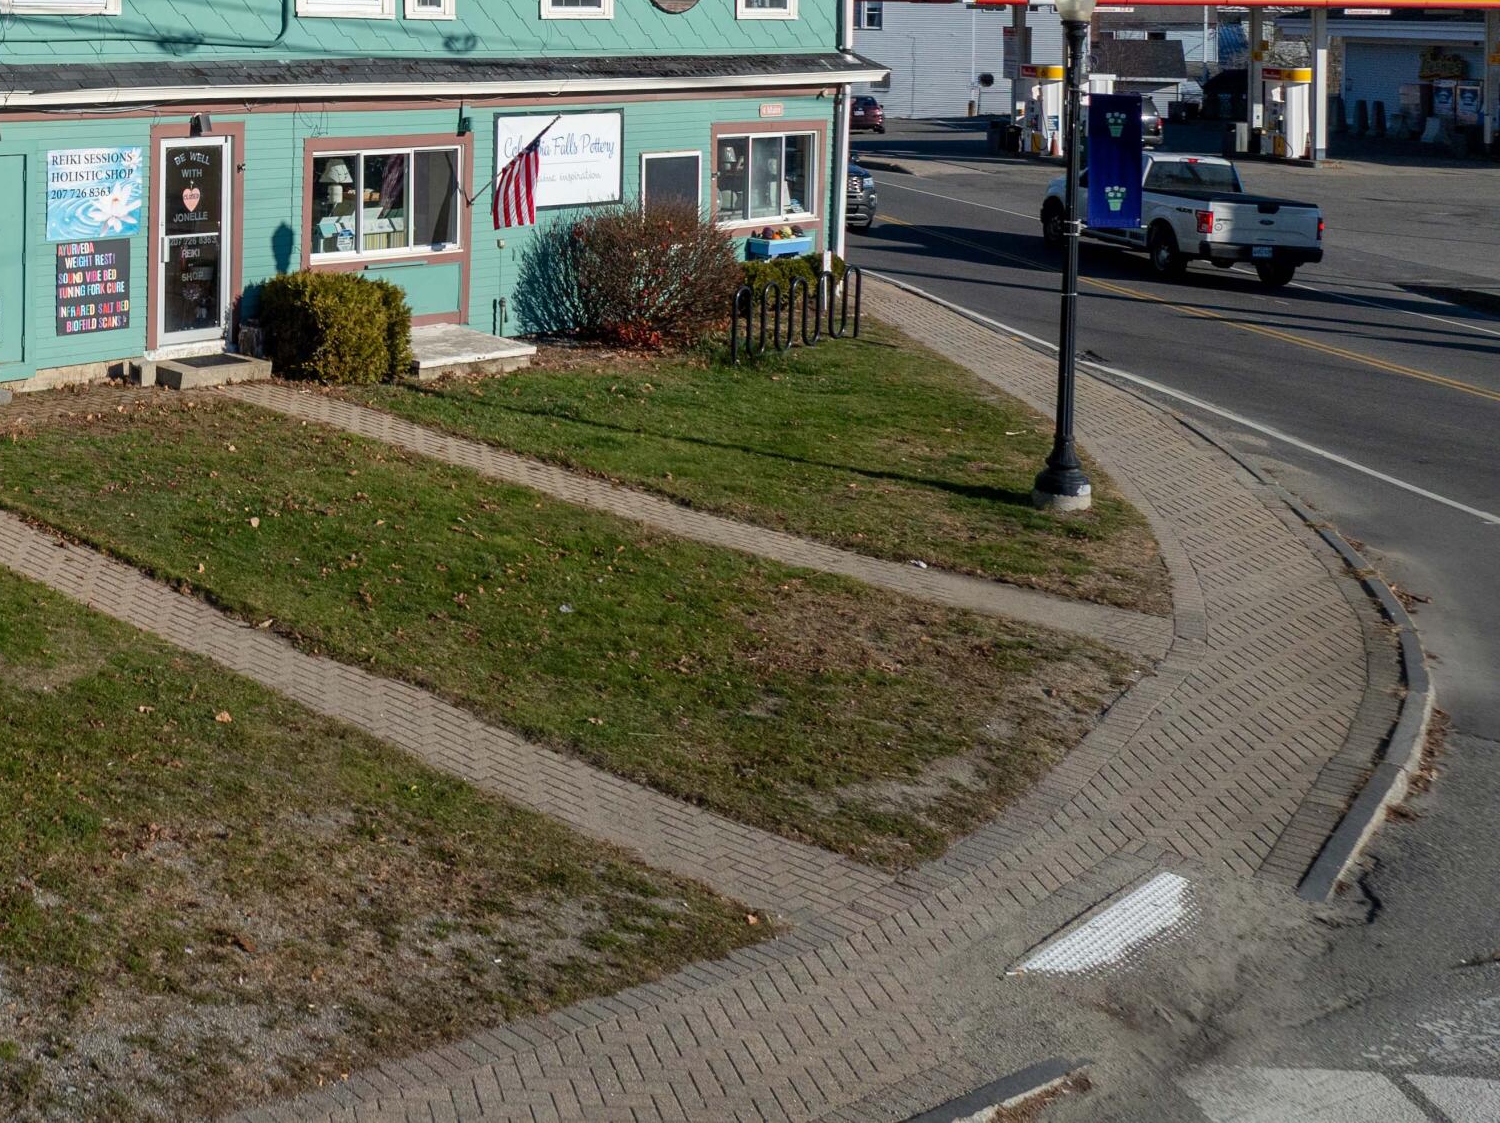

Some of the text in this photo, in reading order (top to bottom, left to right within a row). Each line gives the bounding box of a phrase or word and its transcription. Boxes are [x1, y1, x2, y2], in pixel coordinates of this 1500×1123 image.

[551, 133, 578, 156] Falls
[580, 133, 615, 159] Pottery
[51, 152, 133, 166] REIKI SESSIONS
[174, 151, 210, 166] BE WELL
[51, 168, 134, 183] HOLISTIC SHOP
[181, 168, 203, 178] WITH
[51, 187, 111, 200] 207 726 8363
[173, 211, 209, 222] JONELLE
[58, 242, 95, 256] AYURVEDA
[181, 248, 201, 258] REIKI
[65, 255, 93, 269] WEIGHT
[58, 269, 117, 285] SOUND VIBE BED
[87, 283, 105, 296] FORK
[106, 281, 125, 294] CURE
[59, 300, 129, 318] INFRARED SALT BED
